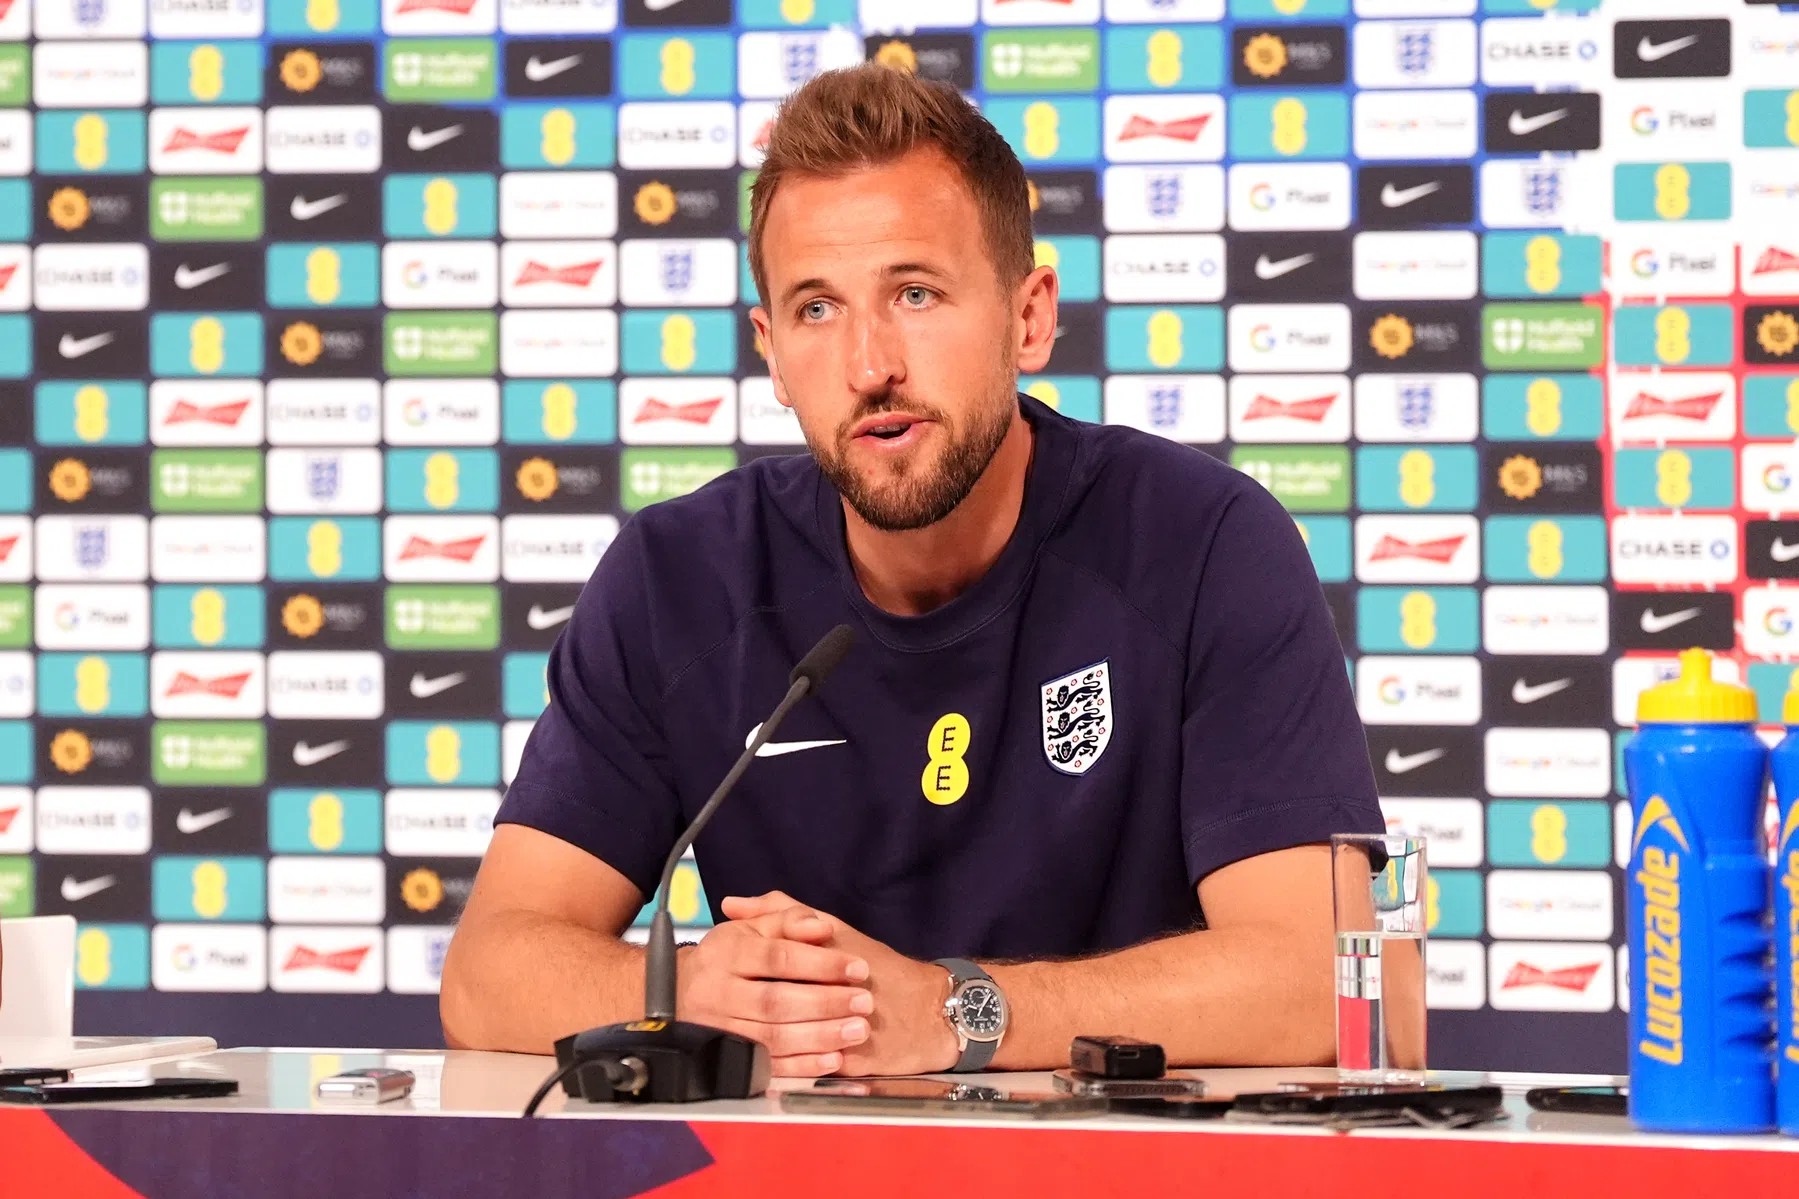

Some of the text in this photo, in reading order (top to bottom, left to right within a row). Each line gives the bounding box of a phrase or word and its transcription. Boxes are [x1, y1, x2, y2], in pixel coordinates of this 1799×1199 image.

[941, 727, 956, 752] E
[936, 765, 951, 791] E
[1637, 845, 1683, 1065] Lucozade
